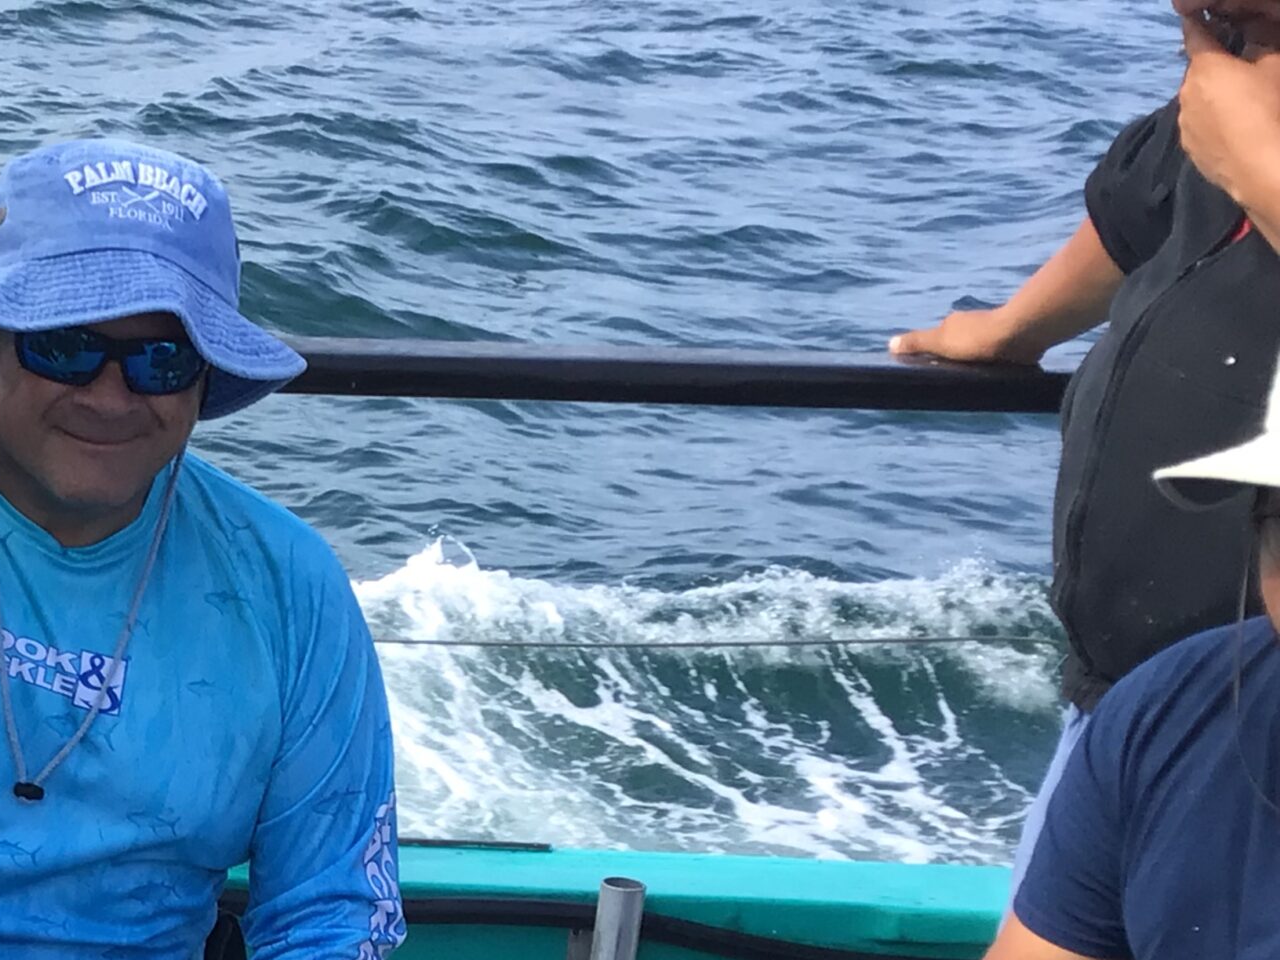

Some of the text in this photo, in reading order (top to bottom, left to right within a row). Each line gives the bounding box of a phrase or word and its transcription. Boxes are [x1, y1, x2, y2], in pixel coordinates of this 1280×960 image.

[63, 160, 208, 220] PALM BEACH
[109, 207, 173, 232] FLORIDA
